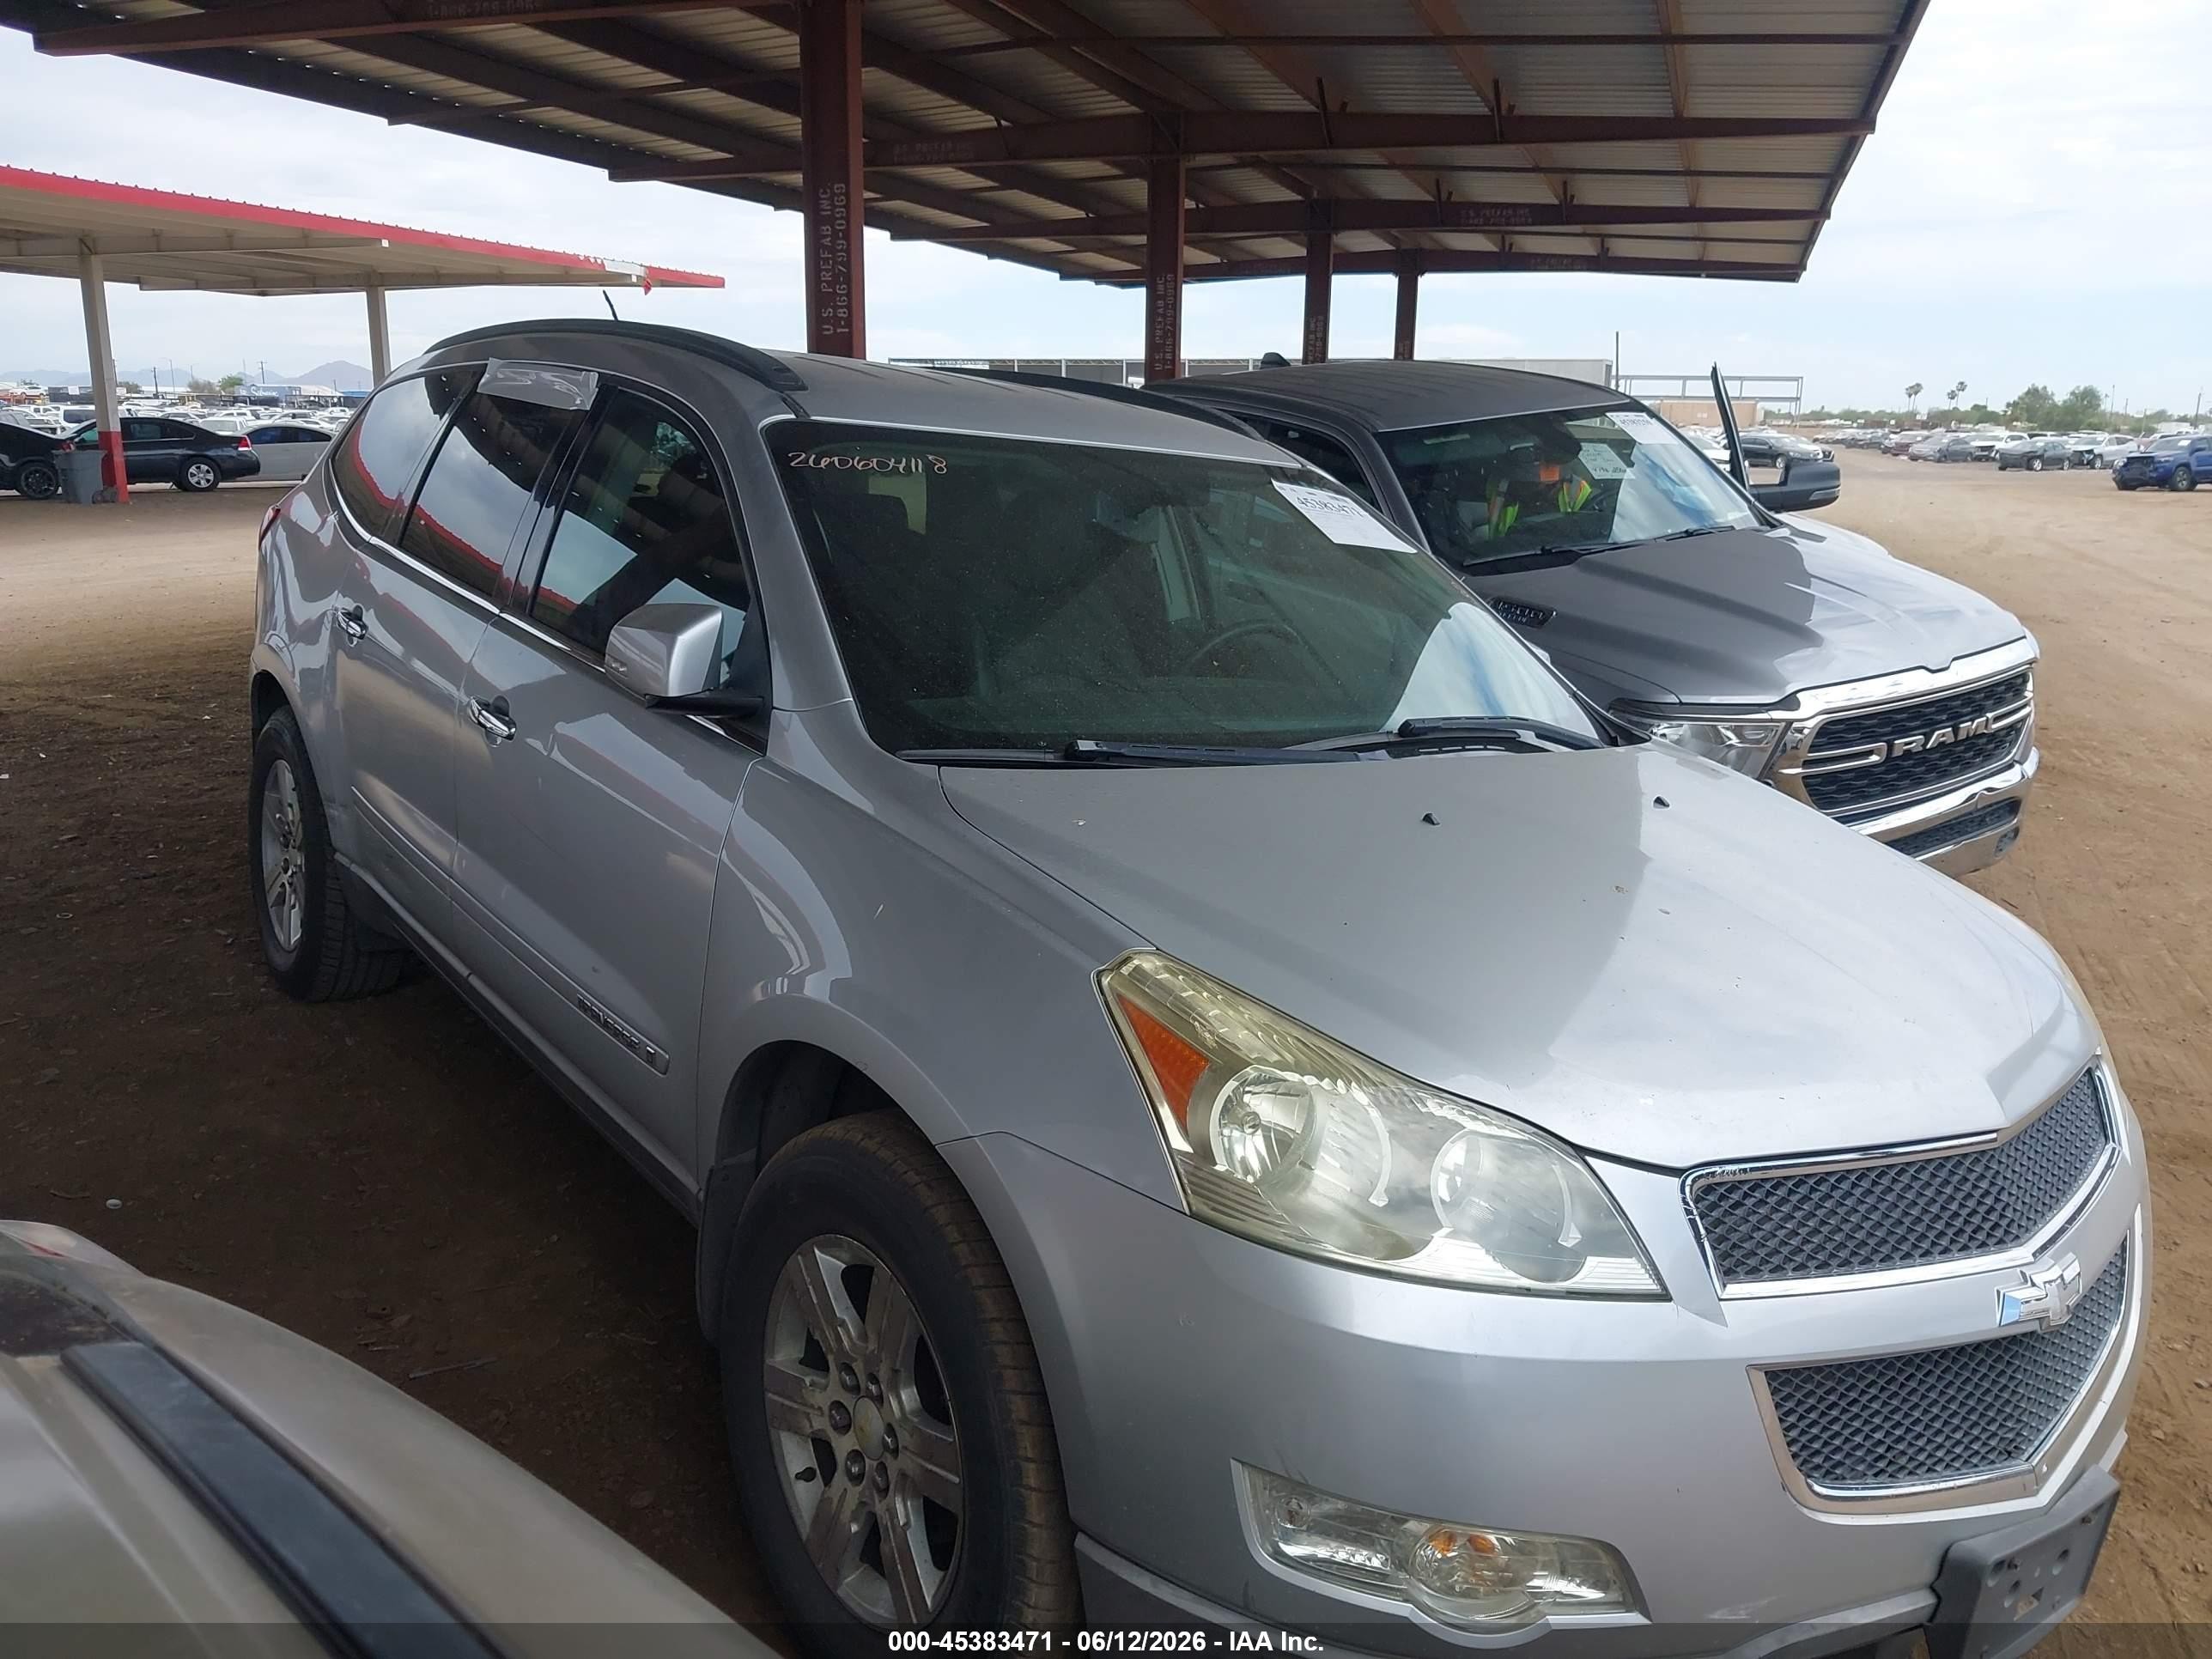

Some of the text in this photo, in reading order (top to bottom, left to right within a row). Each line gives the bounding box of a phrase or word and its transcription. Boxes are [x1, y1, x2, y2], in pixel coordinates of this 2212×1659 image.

[818, 182, 835, 335] U.S. PREFAB INC.
[834, 182, 850, 333] 1-866-799-0969
[788, 452, 947, 474] 260604118
[1297, 496, 1365, 519] 45383471
[1892, 716, 1988, 758] RAM
